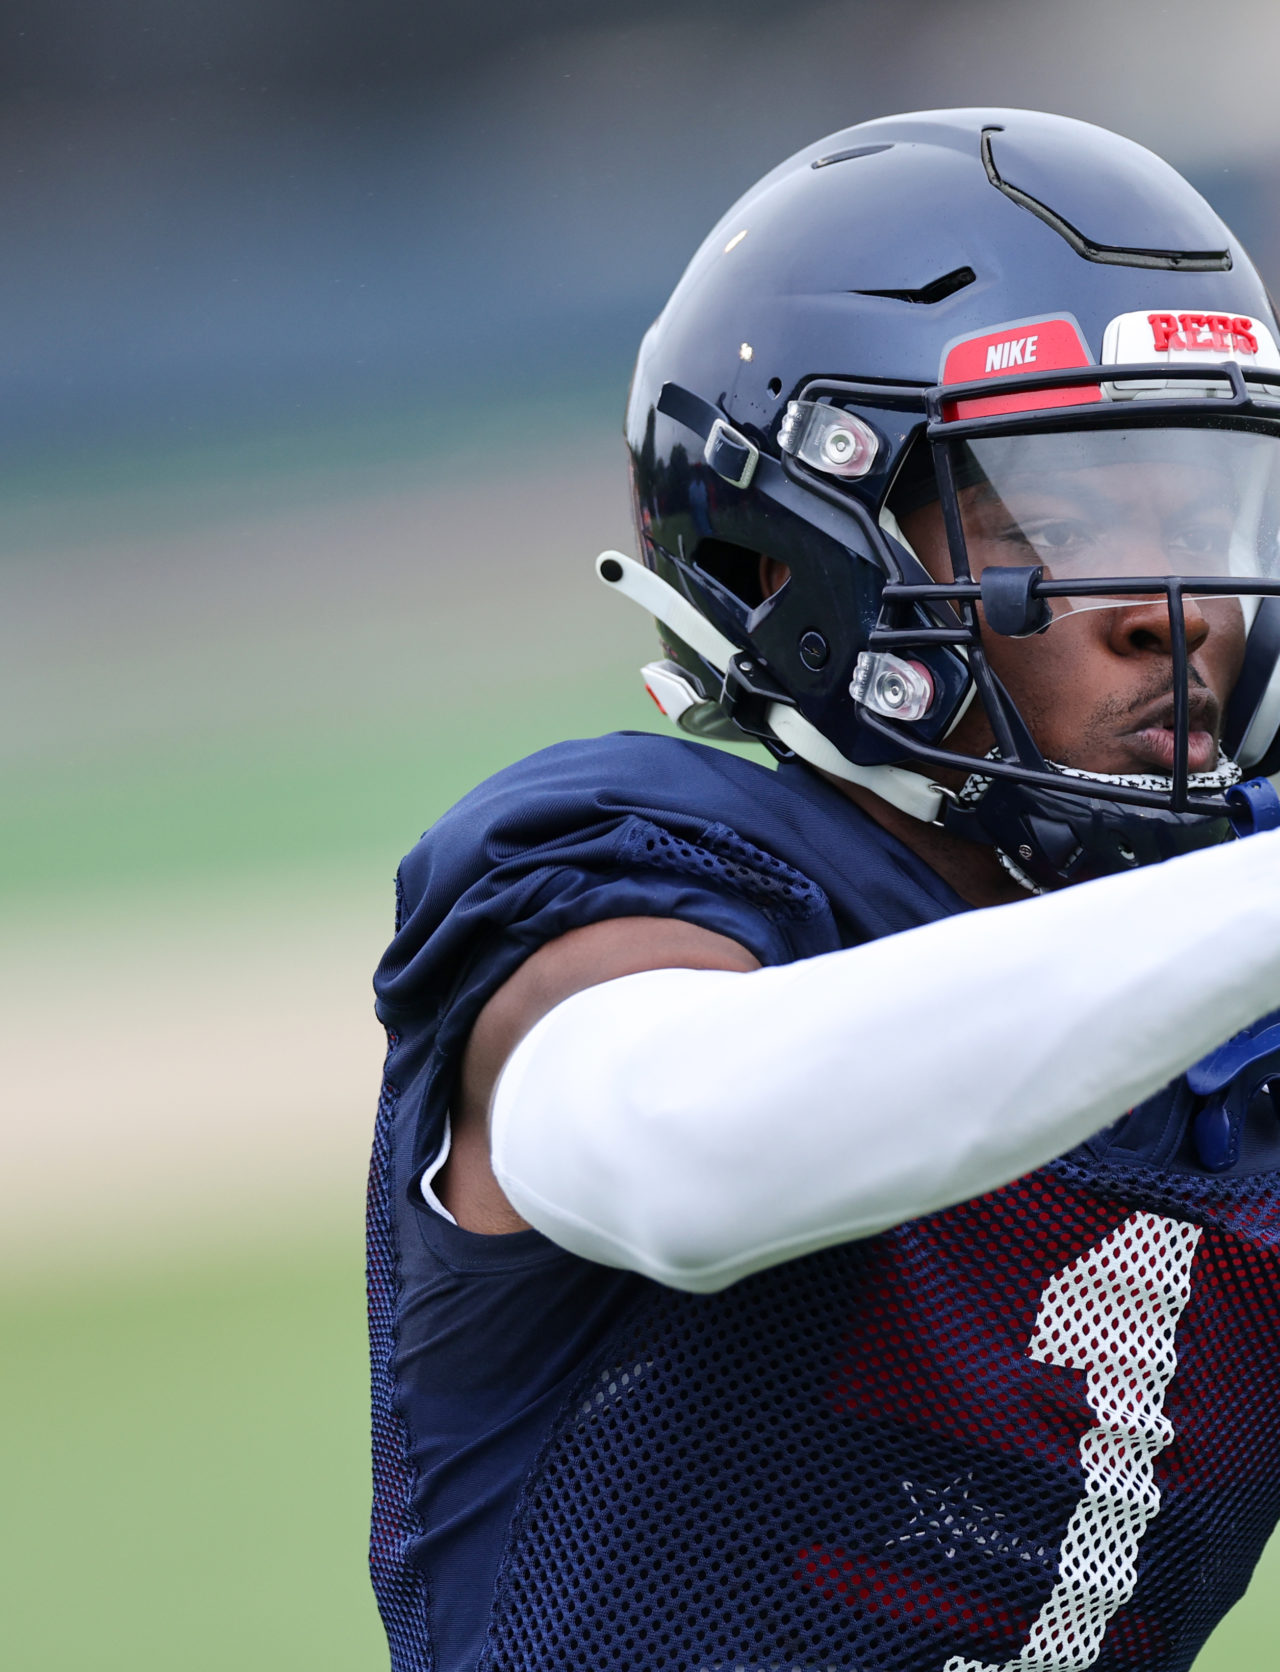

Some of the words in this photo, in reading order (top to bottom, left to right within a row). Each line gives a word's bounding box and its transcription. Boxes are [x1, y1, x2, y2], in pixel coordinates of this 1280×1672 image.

[985, 335, 1038, 372] NIKE
[1147, 314, 1259, 354] REPS
[943, 1211, 1203, 1672] 1
